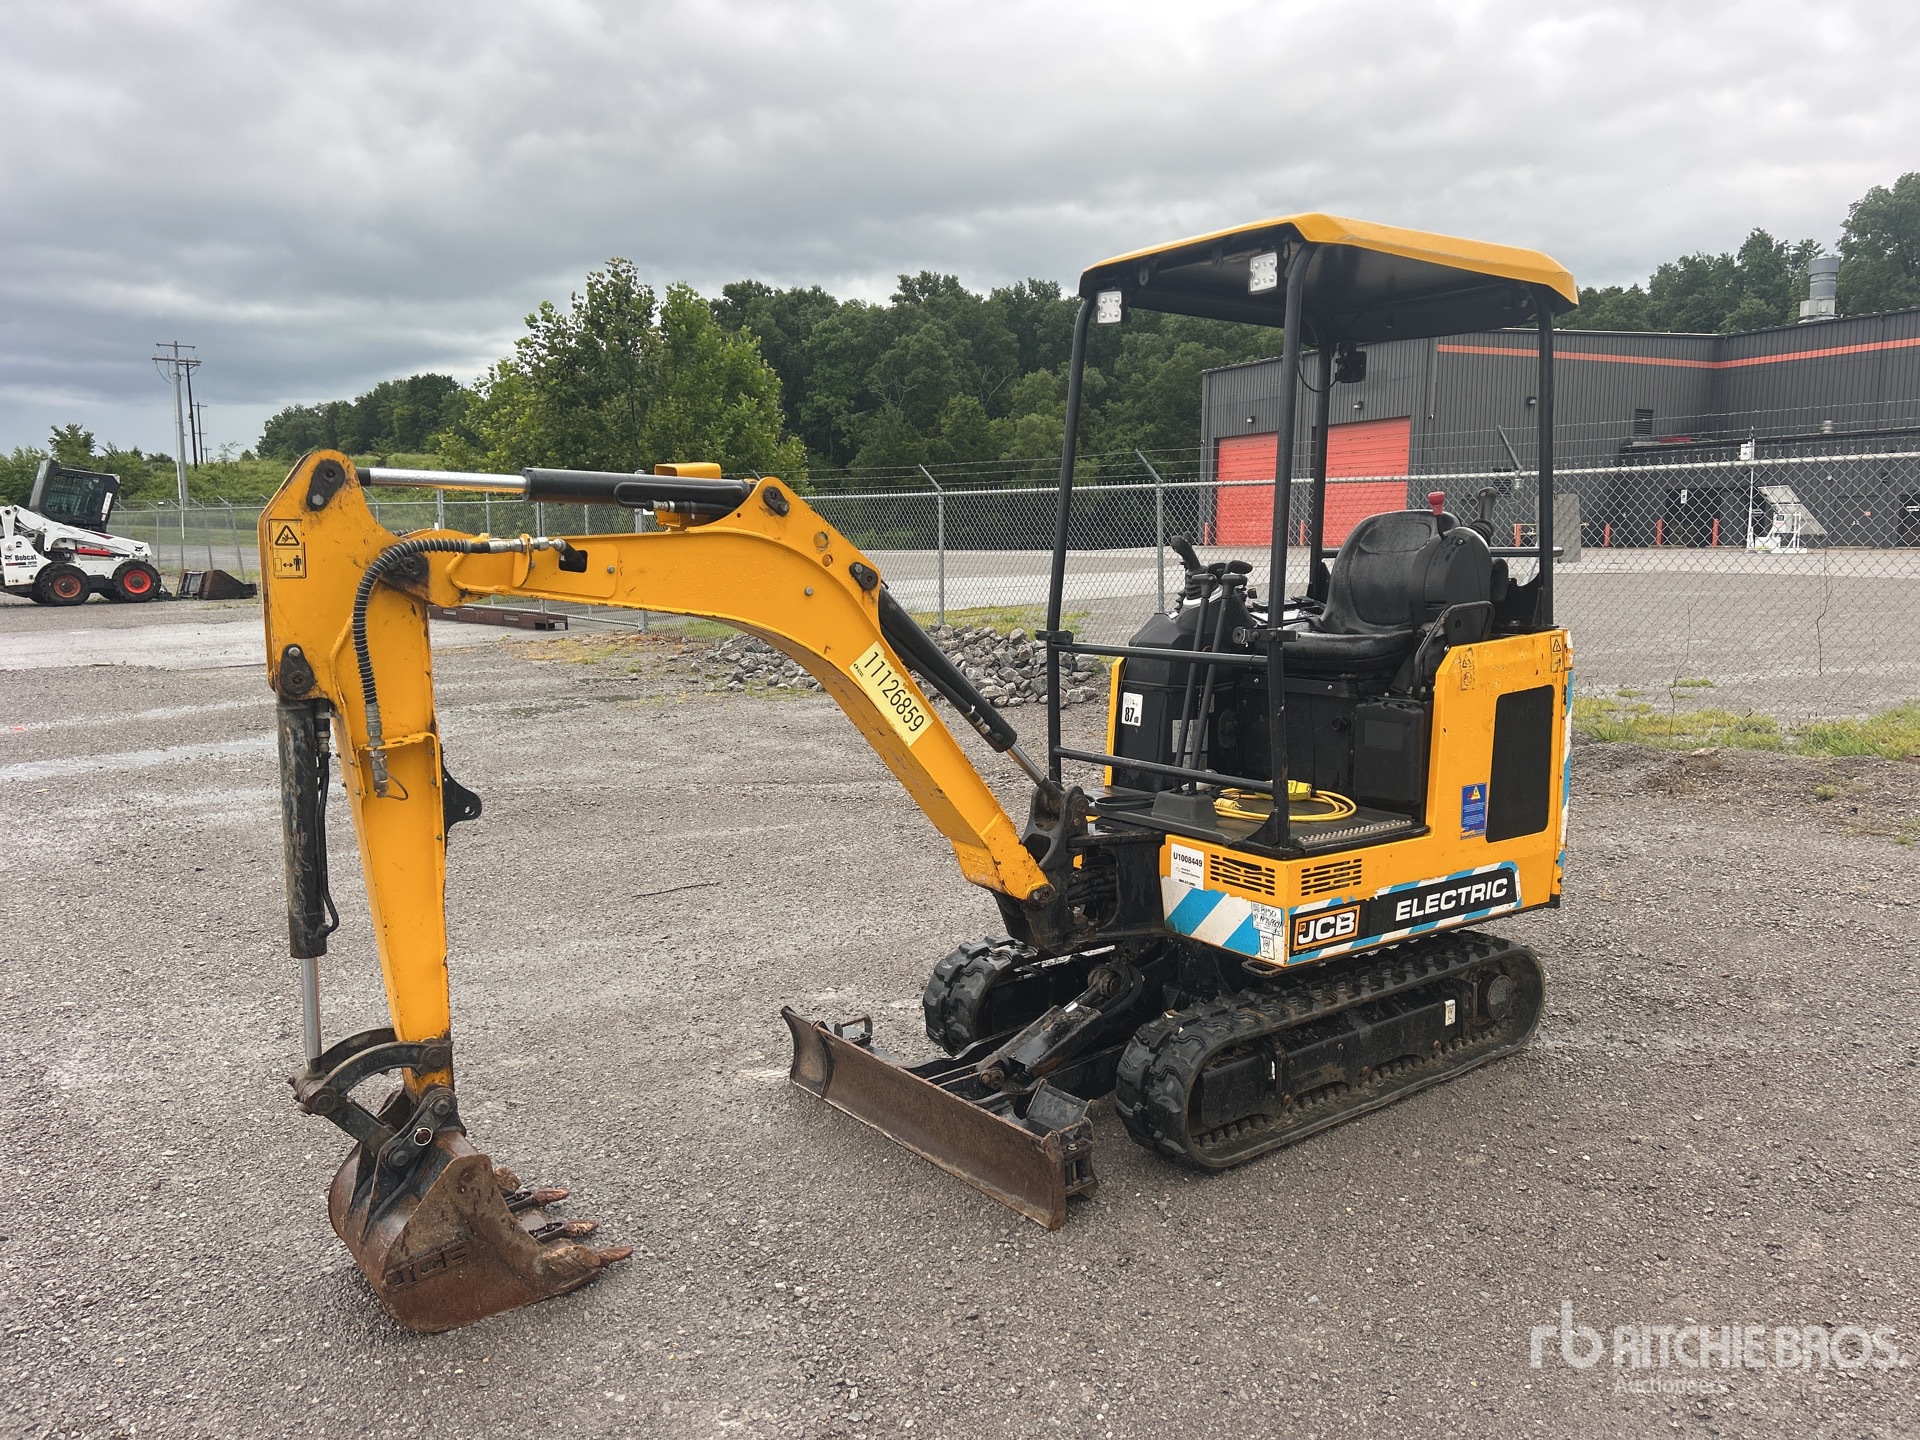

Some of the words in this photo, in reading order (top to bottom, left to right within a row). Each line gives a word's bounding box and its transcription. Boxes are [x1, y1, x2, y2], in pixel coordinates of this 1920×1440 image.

[864, 651, 924, 732] 11126859
[1124, 706, 1135, 723] 87
[1173, 852, 1203, 867] U1008449
[1297, 911, 1357, 945] JCB
[1394, 877, 1509, 922] ELECTRIC
